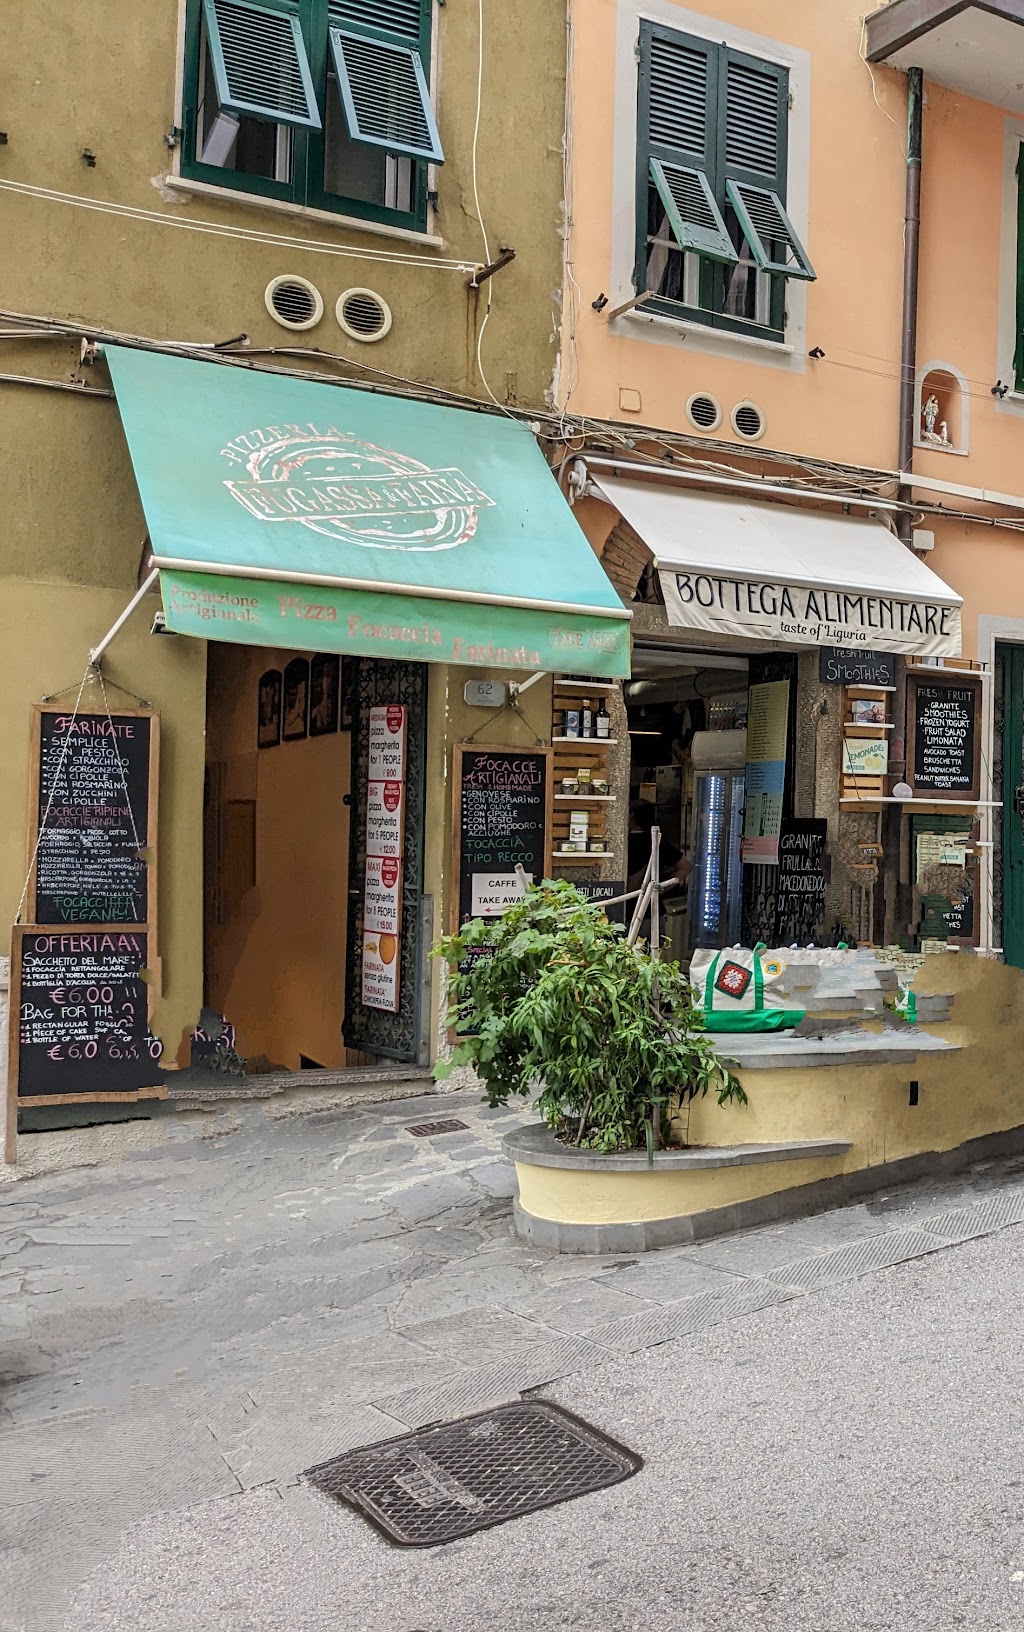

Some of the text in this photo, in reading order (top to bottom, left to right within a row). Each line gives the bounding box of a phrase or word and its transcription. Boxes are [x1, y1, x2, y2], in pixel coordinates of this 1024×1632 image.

[244, 486, 396, 514] FUGASSA
[278, 595, 338, 621] Pizza
[676, 573, 950, 636] BOTTEGA ALIMENTARE
[348, 615, 443, 646] Focaccia
[781, 621, 866, 643] taste of Liguria
[452, 637, 541, 665] Farinata
[477, 683, 493, 694] 62
[947, 691, 972, 701] FRUIT
[931, 702, 959, 710] GRANITE
[924, 708, 968, 719] SMOOTHIES
[53, 716, 134, 738] FARINATE
[920, 717, 970, 728] FROZEN YOGURT
[371, 726, 384, 737] pizza
[925, 727, 966, 737] FRUIT SALAD
[52, 737, 108, 747] SEMPLICE
[927, 736, 963, 746] LIMONATA
[371, 742, 399, 752] margherita
[81, 748, 115, 757] PESTO
[47, 756, 129, 766] CON STRACCHINO
[383, 755, 401, 765] PEOPLE
[473, 755, 537, 772] FOCACCE
[924, 757, 962, 765] BRUSCHETTA
[924, 766, 961, 774] SANDWICHES
[463, 771, 541, 785] ARTIGIANALI
[72, 780, 128, 789] ROSMARINO
[369, 787, 378, 796] BIG
[466, 790, 511, 798] GENOVESE
[489, 795, 540, 803] ROSMARINO
[369, 803, 381, 812] pizza
[488, 822, 536, 830] POMODORO
[380, 831, 398, 841] PEOPLE
[466, 836, 525, 849] FOCACCIA
[464, 852, 533, 863] TIPO RECCO
[368, 862, 380, 872] MAXI
[367, 877, 379, 887] pizza
[488, 880, 517, 888] CAFFE
[478, 896, 500, 904] TAKE
[378, 907, 396, 918] PEOPLE
[23, 952, 77, 966] SACCHETTO
[82, 957, 98, 965] DEL
[365, 961, 384, 972] FARINATA
[20, 1002, 88, 1020] BAG FOR
[32, 1021, 88, 1029] RECTANGULAR
